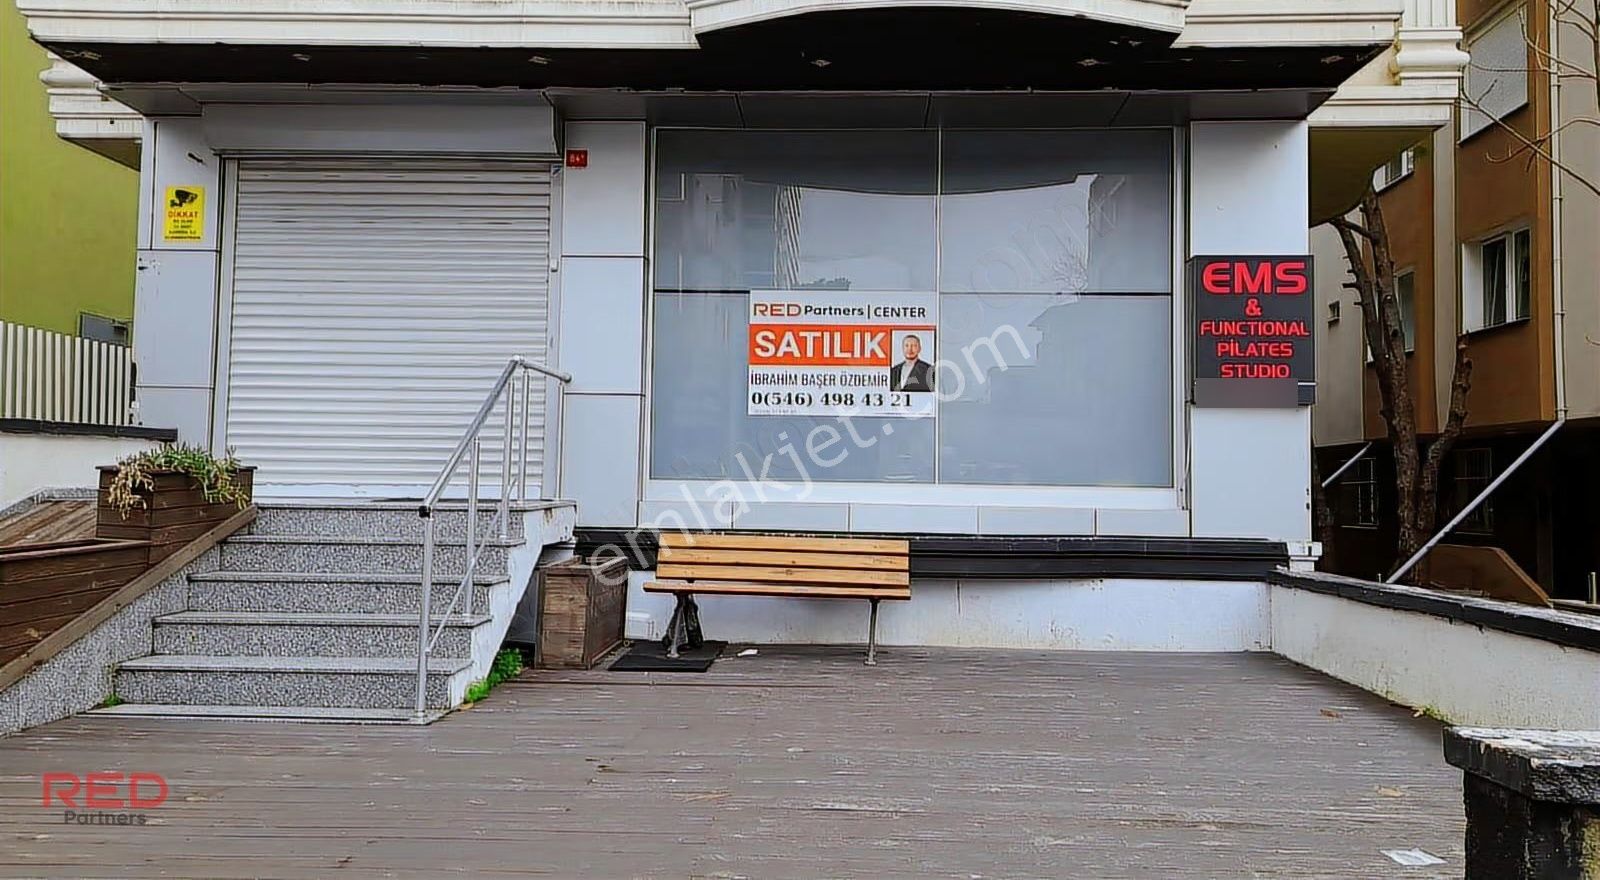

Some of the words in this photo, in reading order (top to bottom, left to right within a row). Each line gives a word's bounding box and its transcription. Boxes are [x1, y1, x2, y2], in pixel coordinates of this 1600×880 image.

[1202, 261, 1307, 294] EMS
[753, 303, 801, 317] RED
[804, 304, 864, 317] Partners
[874, 306, 926, 318] CENTER
[1245, 298, 1262, 317] &
[1200, 321, 1310, 336] FUNCTIONAL
[754, 329, 887, 359] SATILIK
[1217, 338, 1293, 357] PİLATES
[750, 370, 798, 386] İBRAHİM
[801, 373, 836, 389] BAŞER
[839, 370, 888, 387] ÖZDEMİR
[1221, 364, 1290, 378] STUDIO
[751, 392, 813, 409] 0(546)
[820, 392, 854, 407] 498
[861, 393, 884, 407] 43
[890, 393, 913, 407] 21
